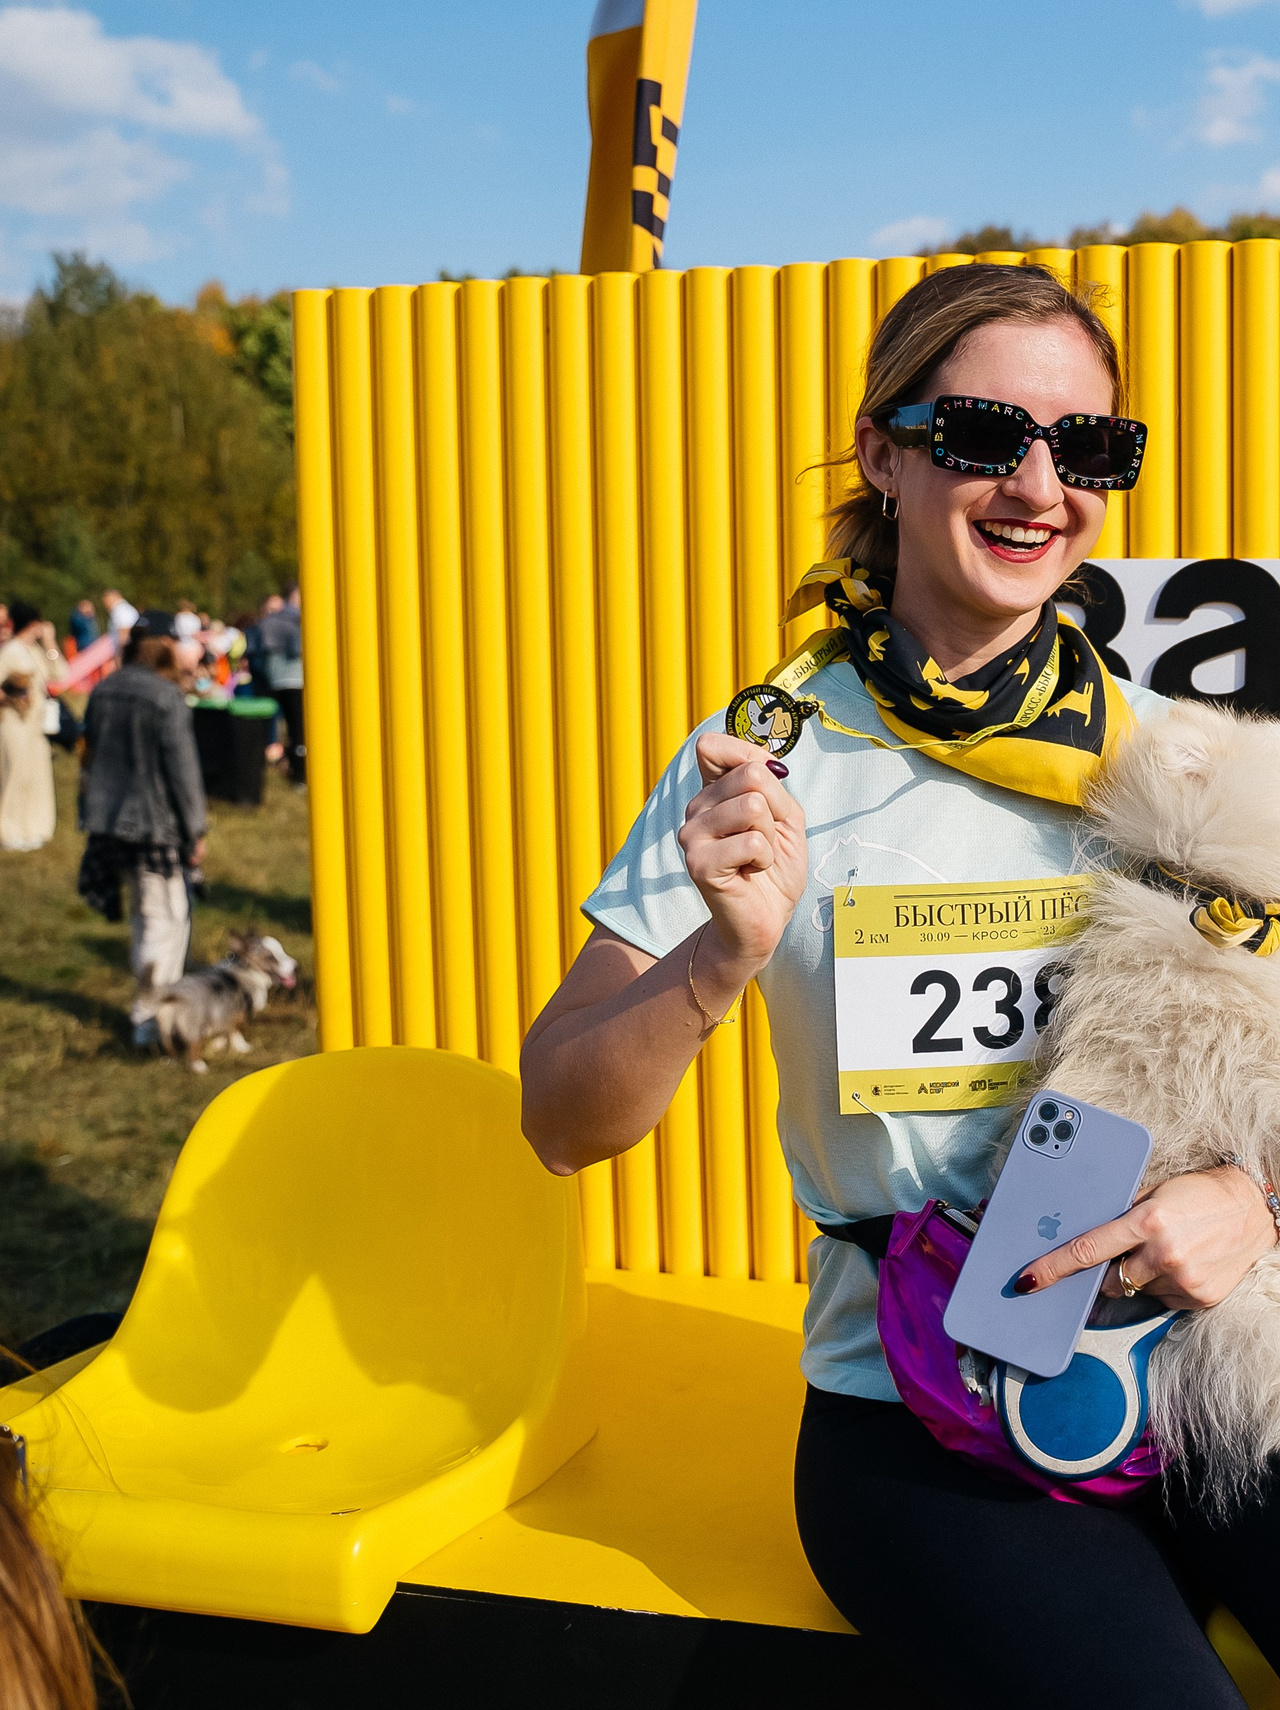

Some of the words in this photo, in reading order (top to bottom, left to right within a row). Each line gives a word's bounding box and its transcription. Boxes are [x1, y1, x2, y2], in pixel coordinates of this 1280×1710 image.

[894, 895, 1032, 928] БЫСТРЫЙ
[854, 929, 865, 944] 2
[920, 931, 951, 942] 30.09
[972, 929, 1019, 940] КРОСС
